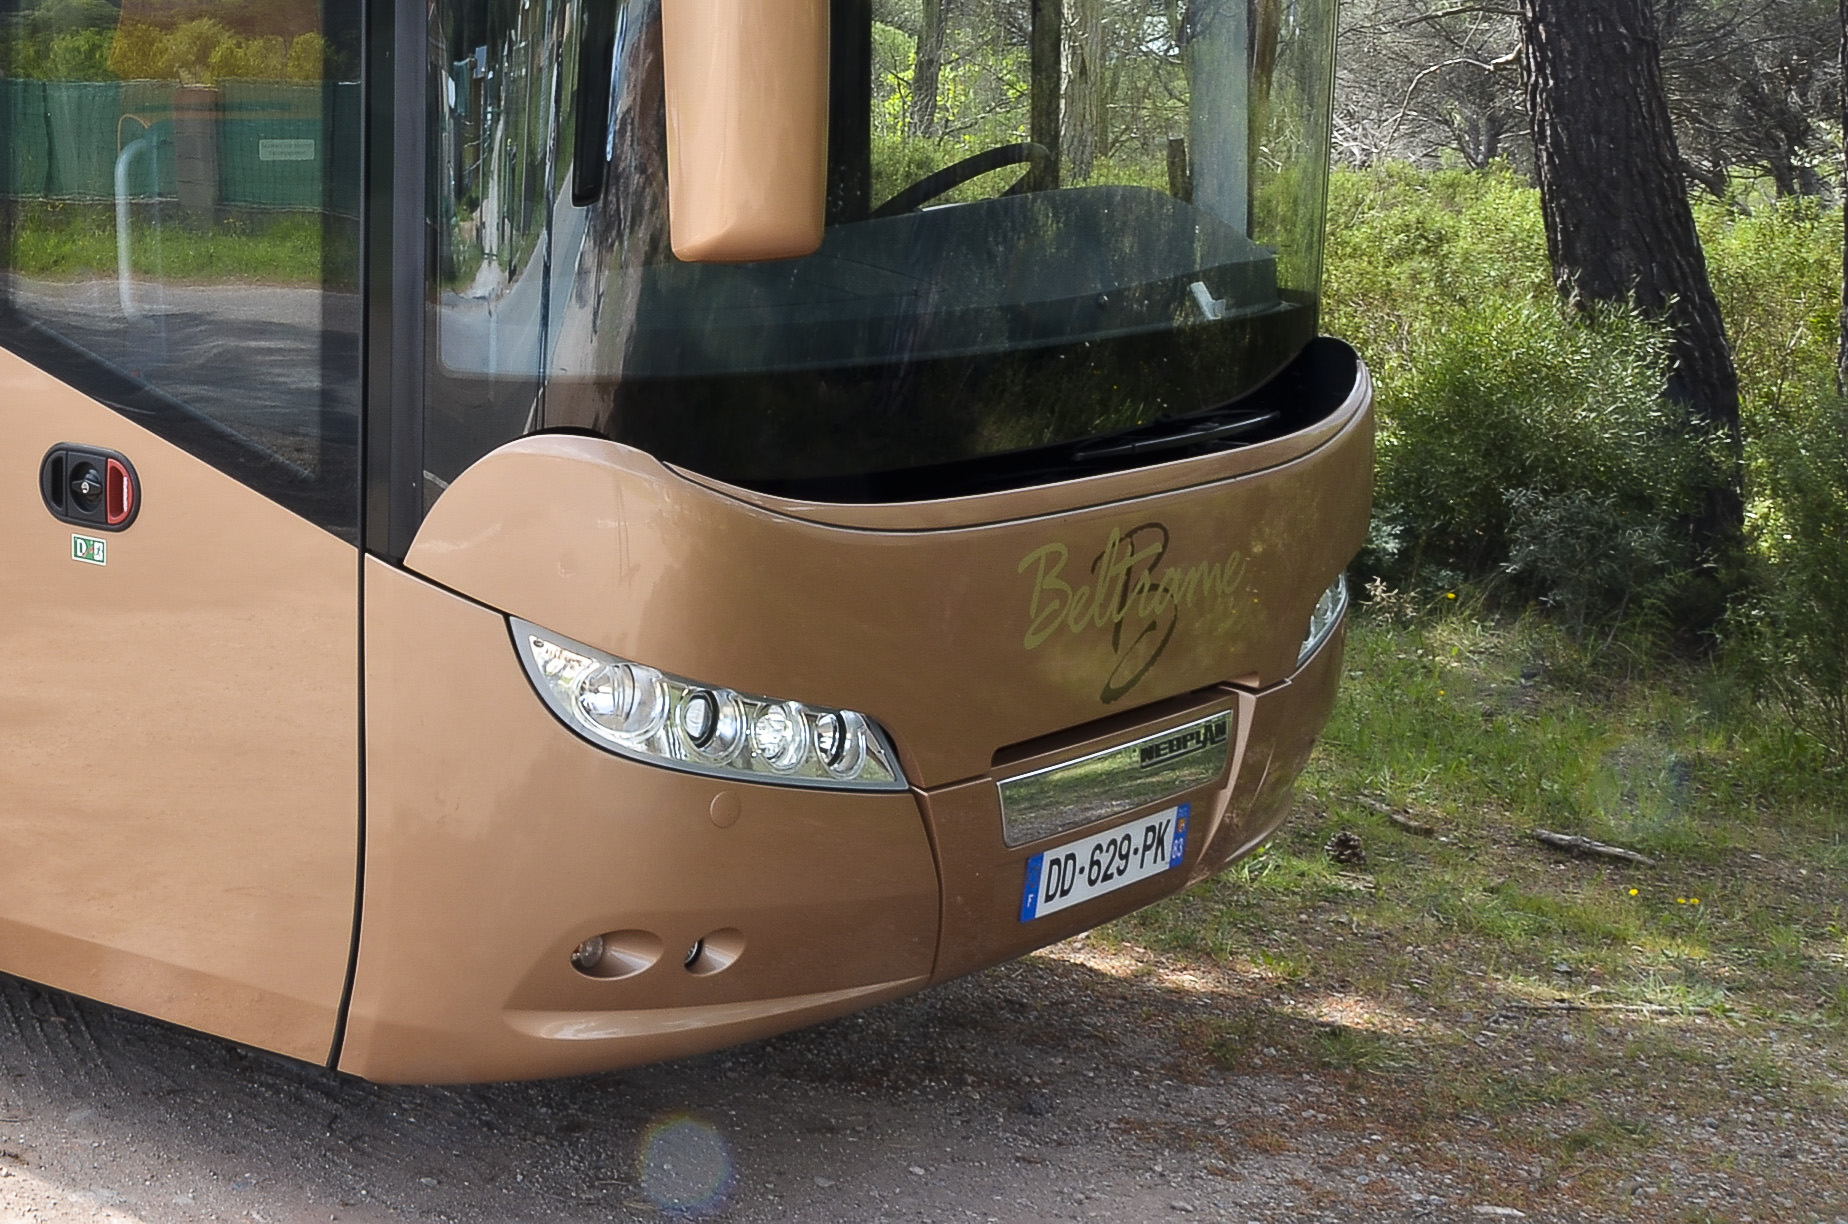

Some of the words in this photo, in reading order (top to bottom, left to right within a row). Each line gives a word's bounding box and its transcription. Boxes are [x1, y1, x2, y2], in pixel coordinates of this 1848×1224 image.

[1018, 527, 1246, 650] Beltrame
[1140, 720, 1227, 768] NEOPLAN
[1172, 837, 1184, 859] 83
